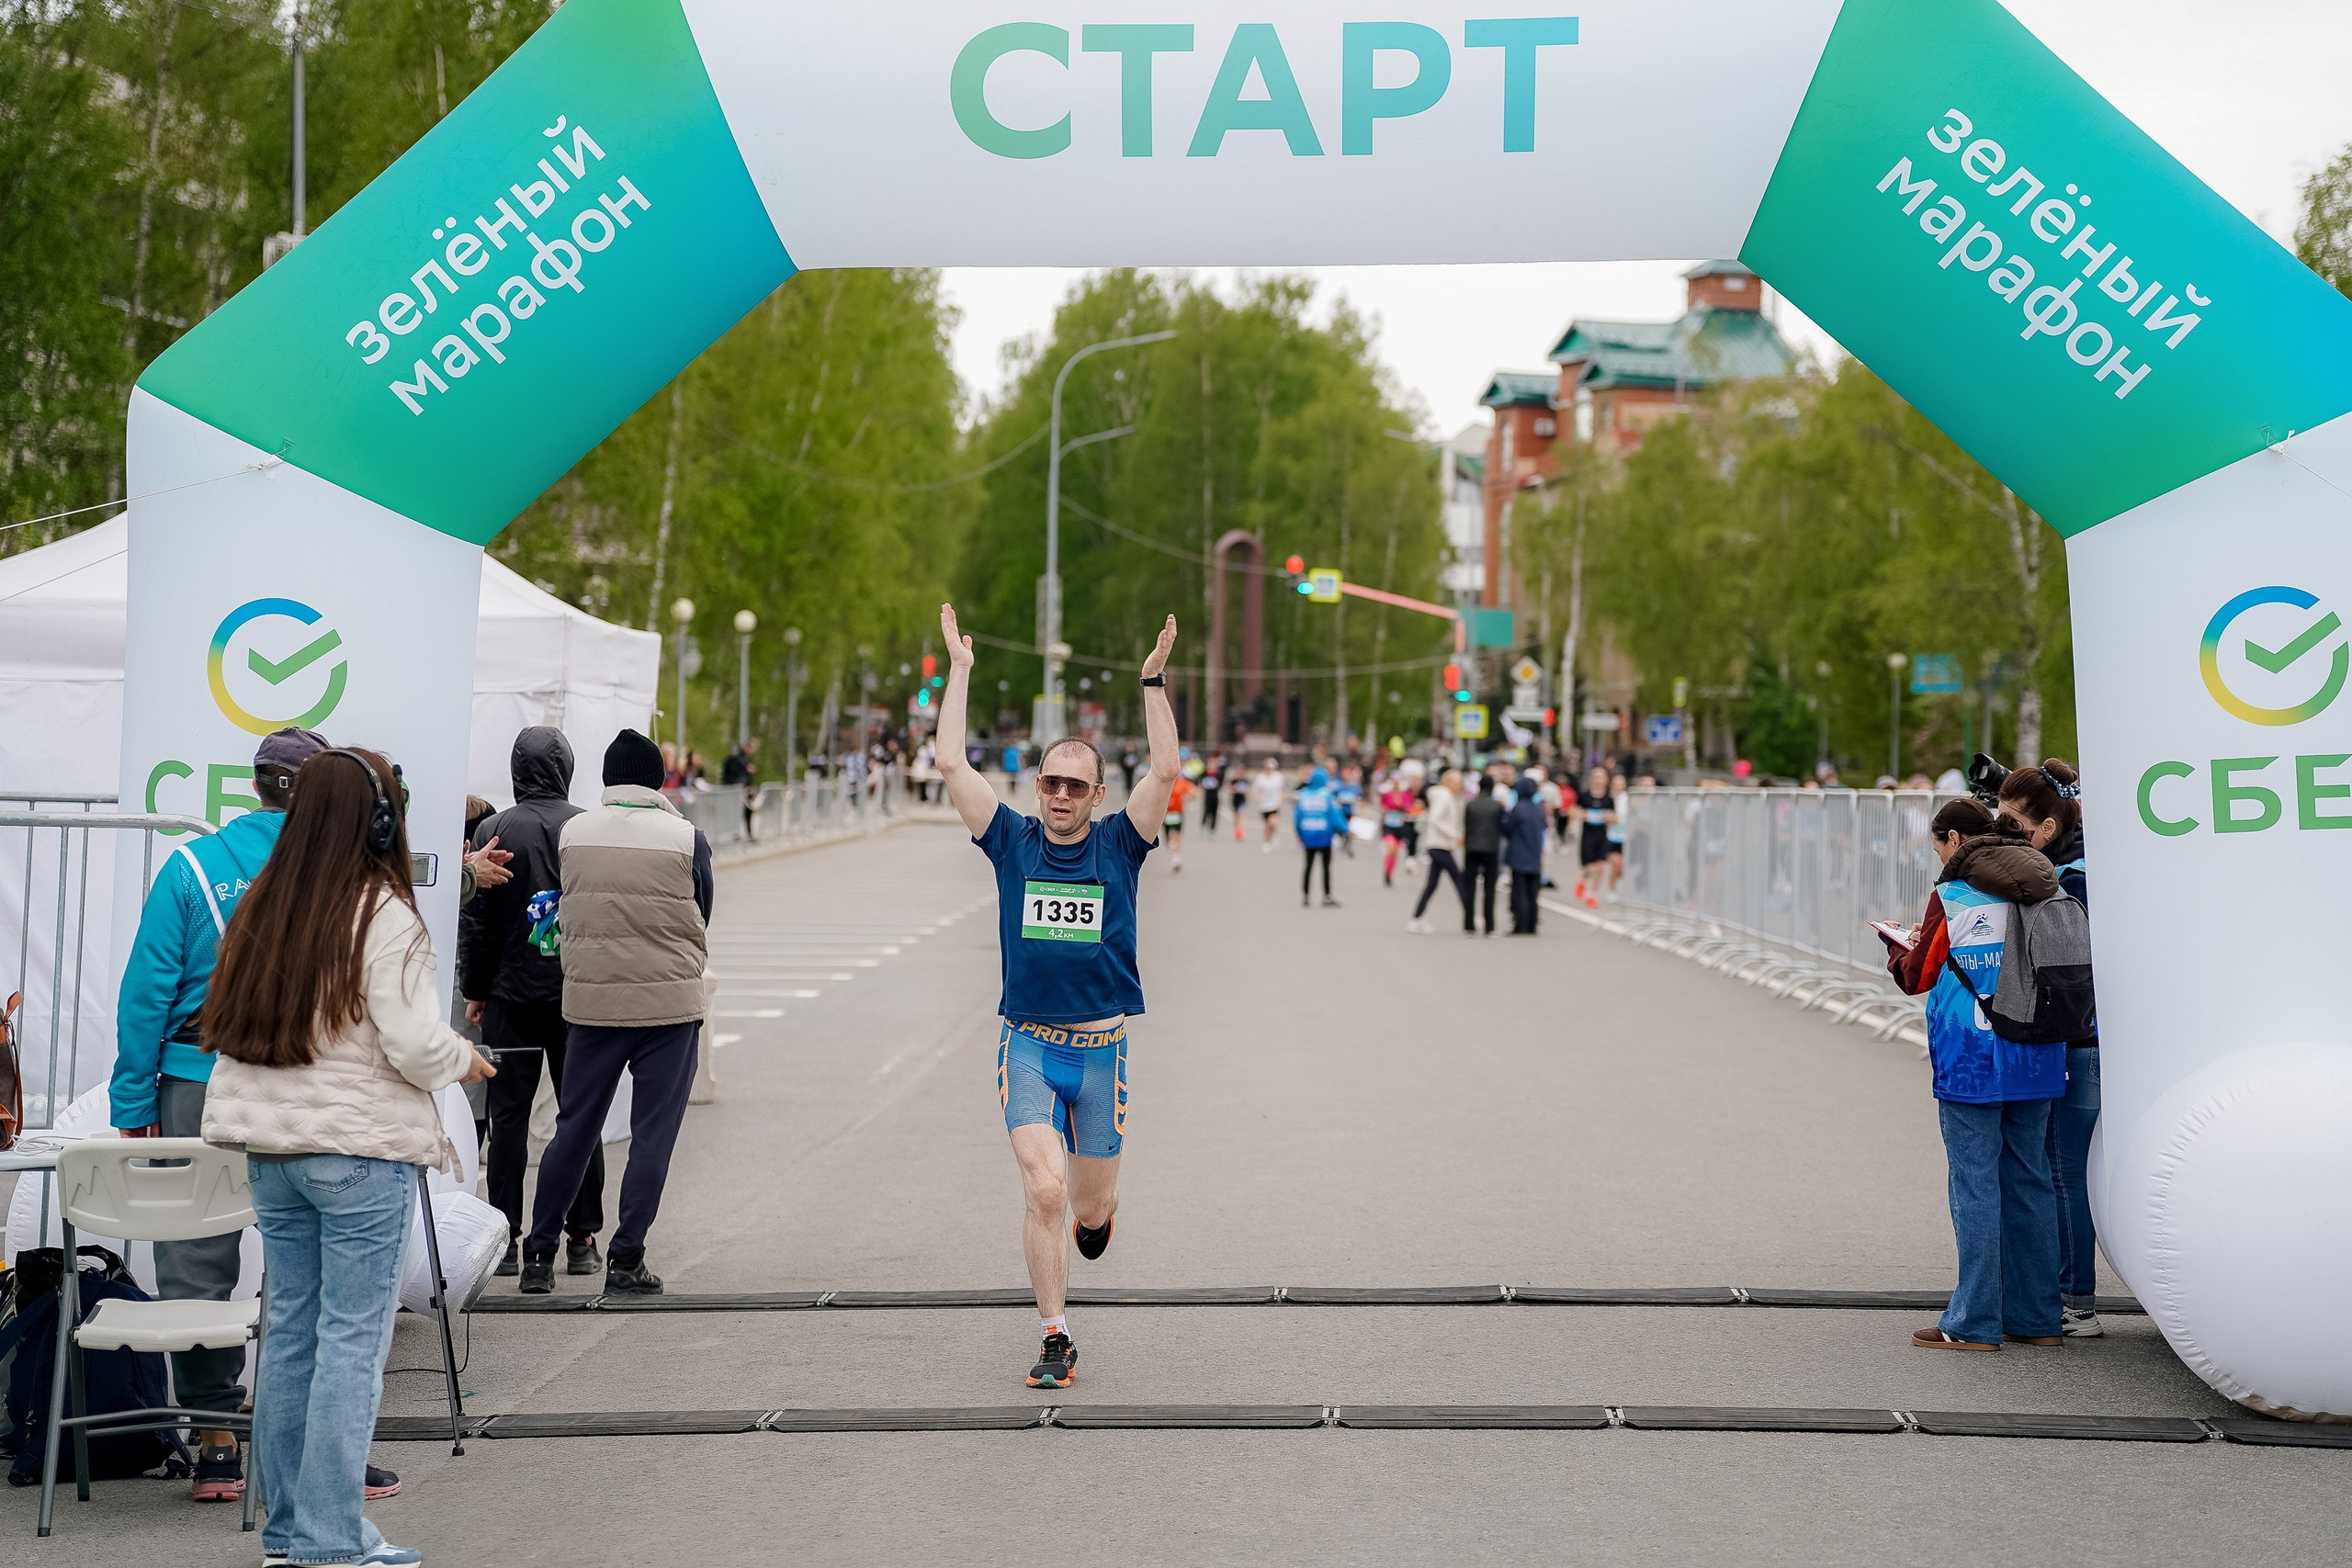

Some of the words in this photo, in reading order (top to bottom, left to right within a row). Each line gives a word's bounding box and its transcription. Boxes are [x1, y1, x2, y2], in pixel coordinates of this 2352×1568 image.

[950, 17, 1579, 160] СТАРТ
[345, 114, 606, 365] зелёный
[389, 175, 651, 416] марафон
[1875, 156, 2152, 400] марафон
[1926, 107, 2212, 350] зелёный
[2136, 753, 2352, 837] СБЕ
[215, 878, 251, 901] RA
[1033, 899, 1094, 924] 1335
[1018, 1021, 1069, 1045] PRO
